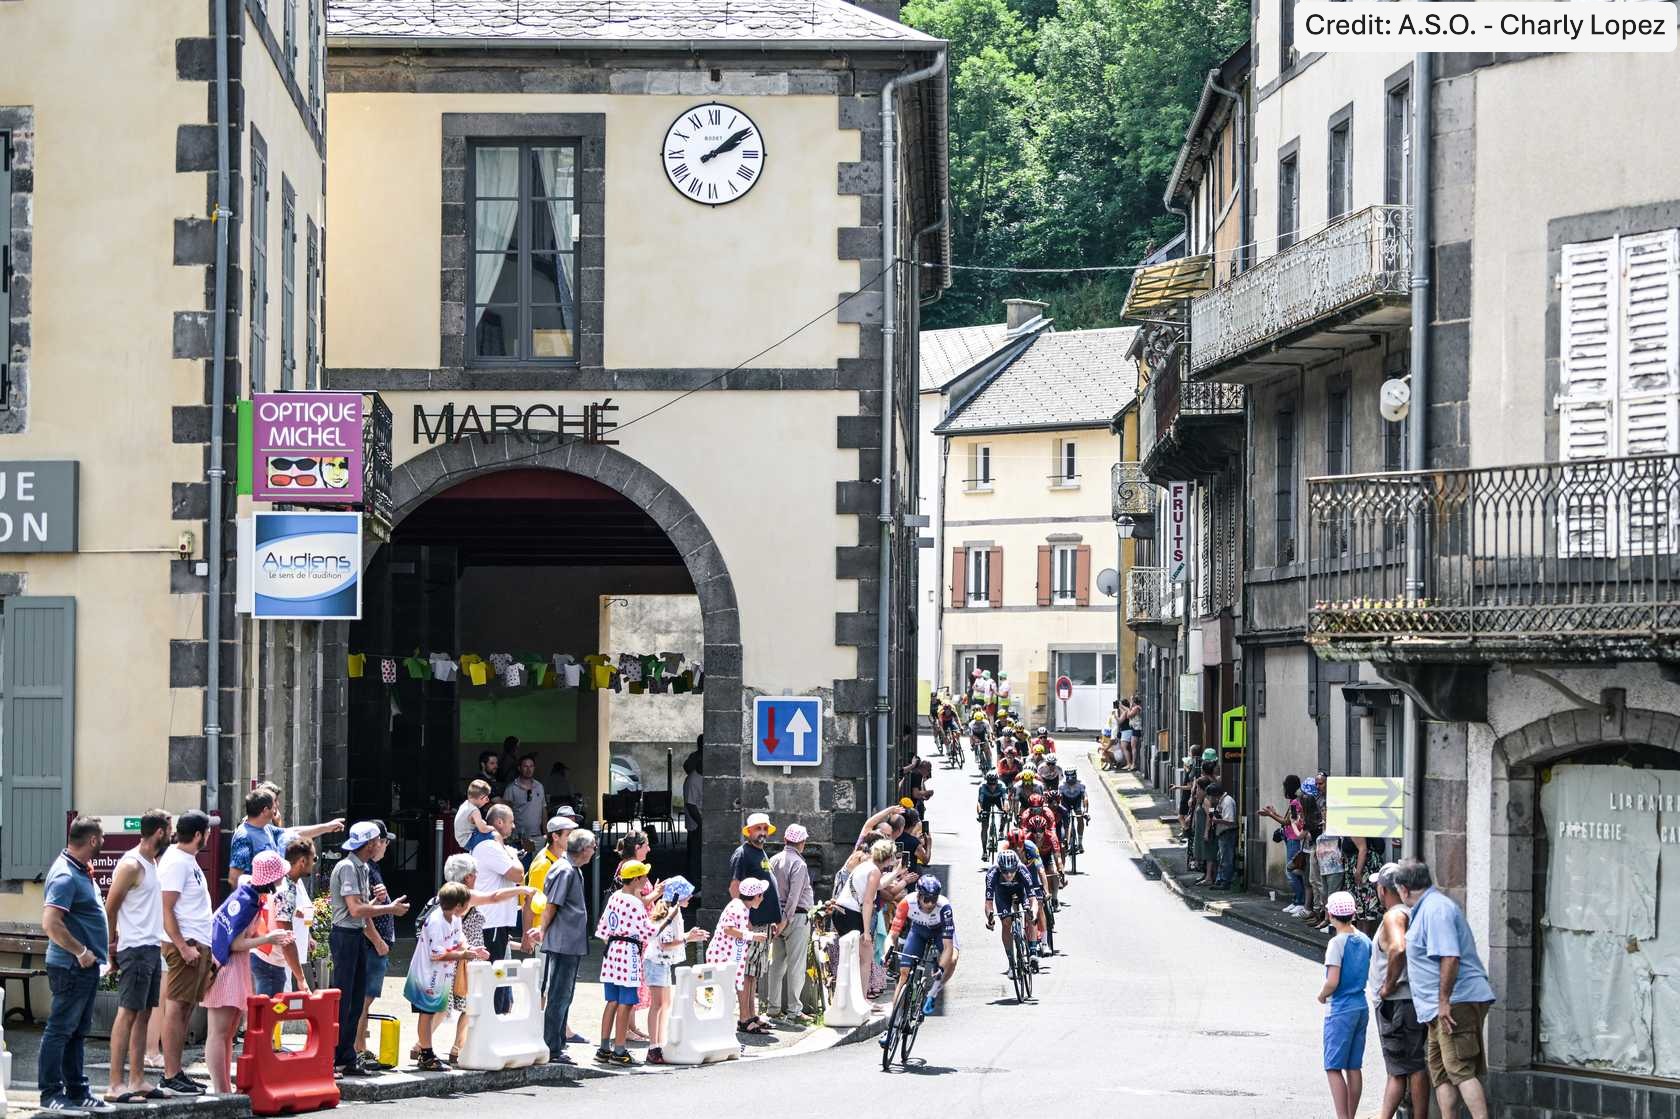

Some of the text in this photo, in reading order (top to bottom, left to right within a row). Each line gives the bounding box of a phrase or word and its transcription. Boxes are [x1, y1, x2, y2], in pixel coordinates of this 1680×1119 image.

[688, 113, 703, 131] XI
[708, 109, 721, 126] XII
[728, 115, 737, 130] I
[673, 129, 690, 142] X
[668, 149, 685, 160] IX
[742, 150, 759, 159] III
[672, 163, 691, 184] VIII
[736, 164, 755, 182] IIII
[687, 177, 703, 197] VII
[708, 183, 719, 200] VI
[728, 179, 738, 196] V
[259, 402, 356, 425] OPTIQUE
[413, 398, 620, 446] MARCHÉ
[269, 426, 347, 447] MICHEL
[1173, 486, 1184, 562] FRUITS
[262, 551, 351, 569] Audiens
[1559, 821, 1622, 841] PAPETERIE
